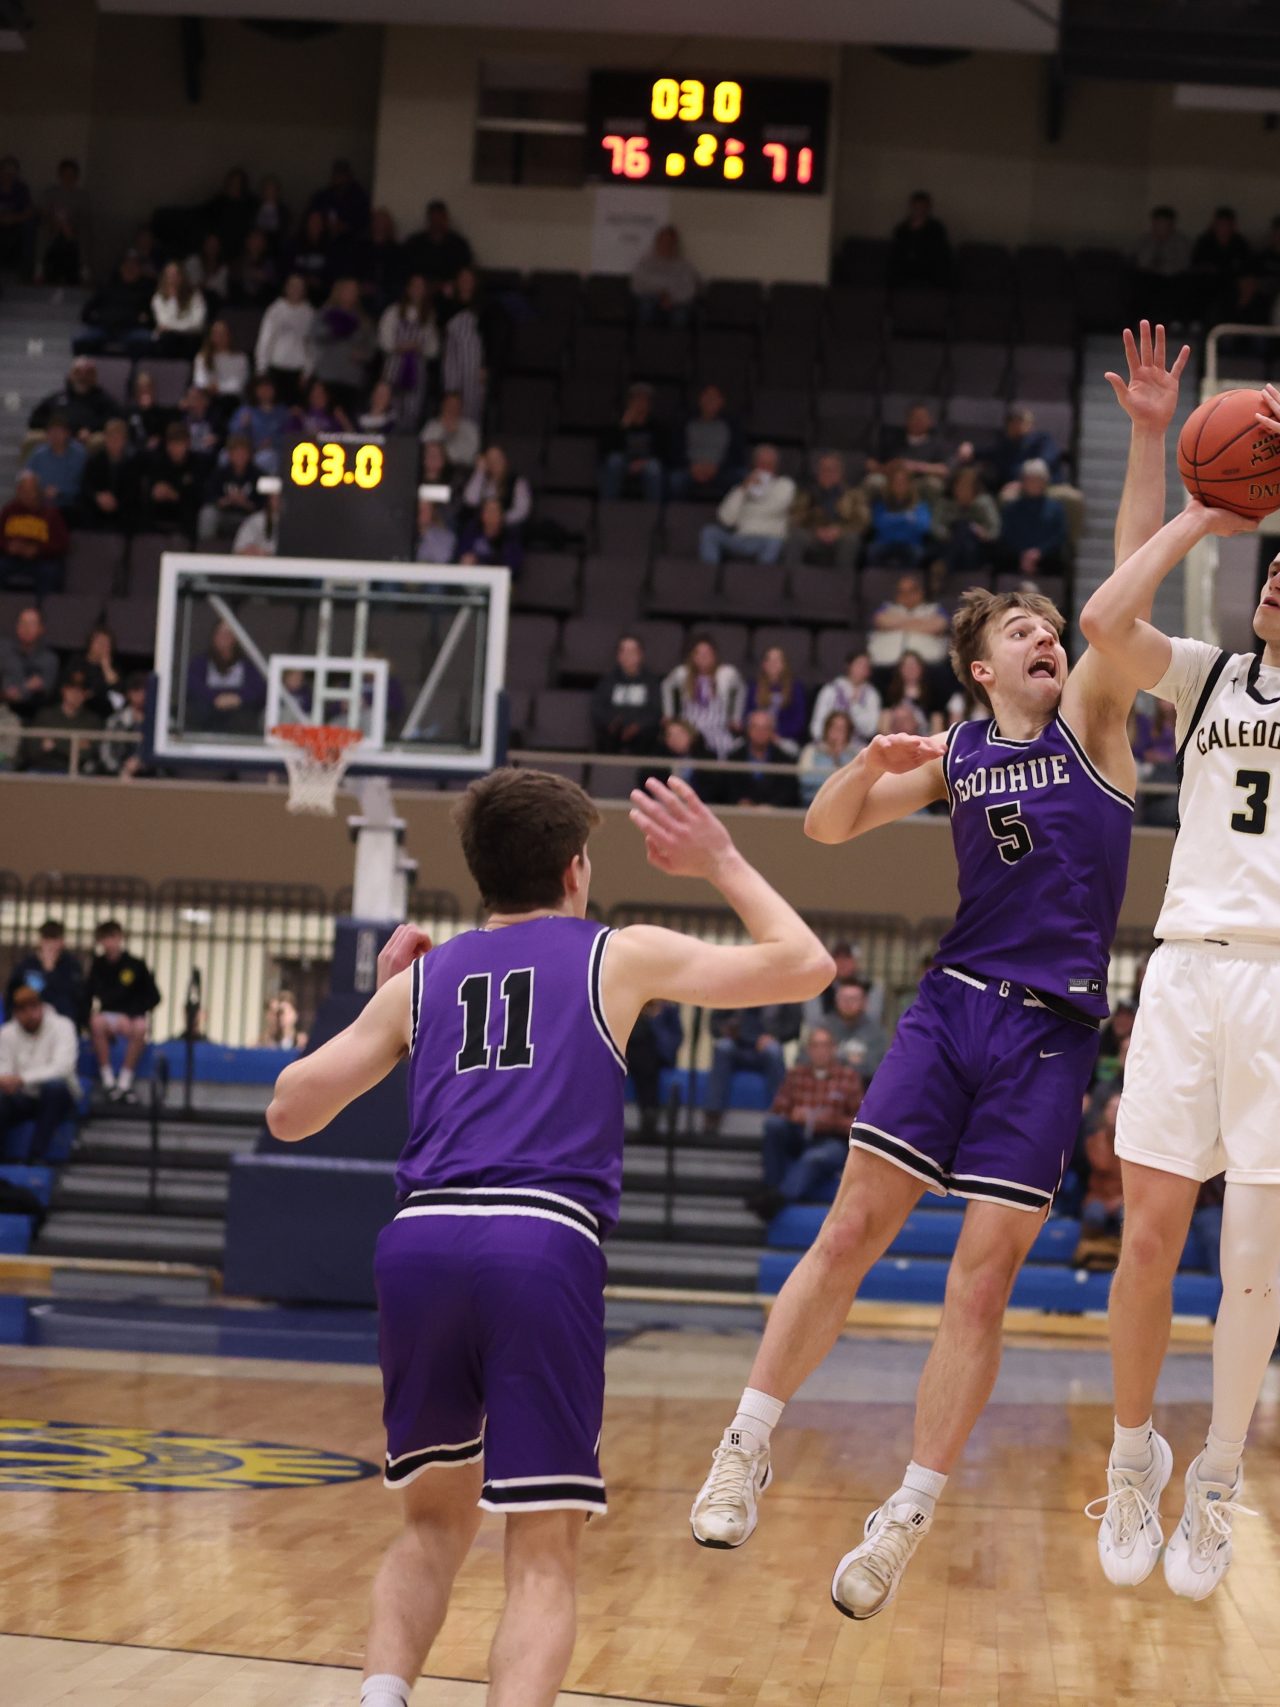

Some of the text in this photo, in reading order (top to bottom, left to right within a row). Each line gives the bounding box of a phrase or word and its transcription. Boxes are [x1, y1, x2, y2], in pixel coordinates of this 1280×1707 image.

[601, 135, 650, 179] 76
[693, 133, 718, 167] 2
[762, 142, 813, 184] 71
[290, 441, 384, 489] 03.0
[1229, 768, 1272, 836] 3
[984, 799, 1035, 866] 5
[998, 979, 1011, 998] G
[1091, 983, 1099, 991] M
[455, 966, 535, 1076] 11
